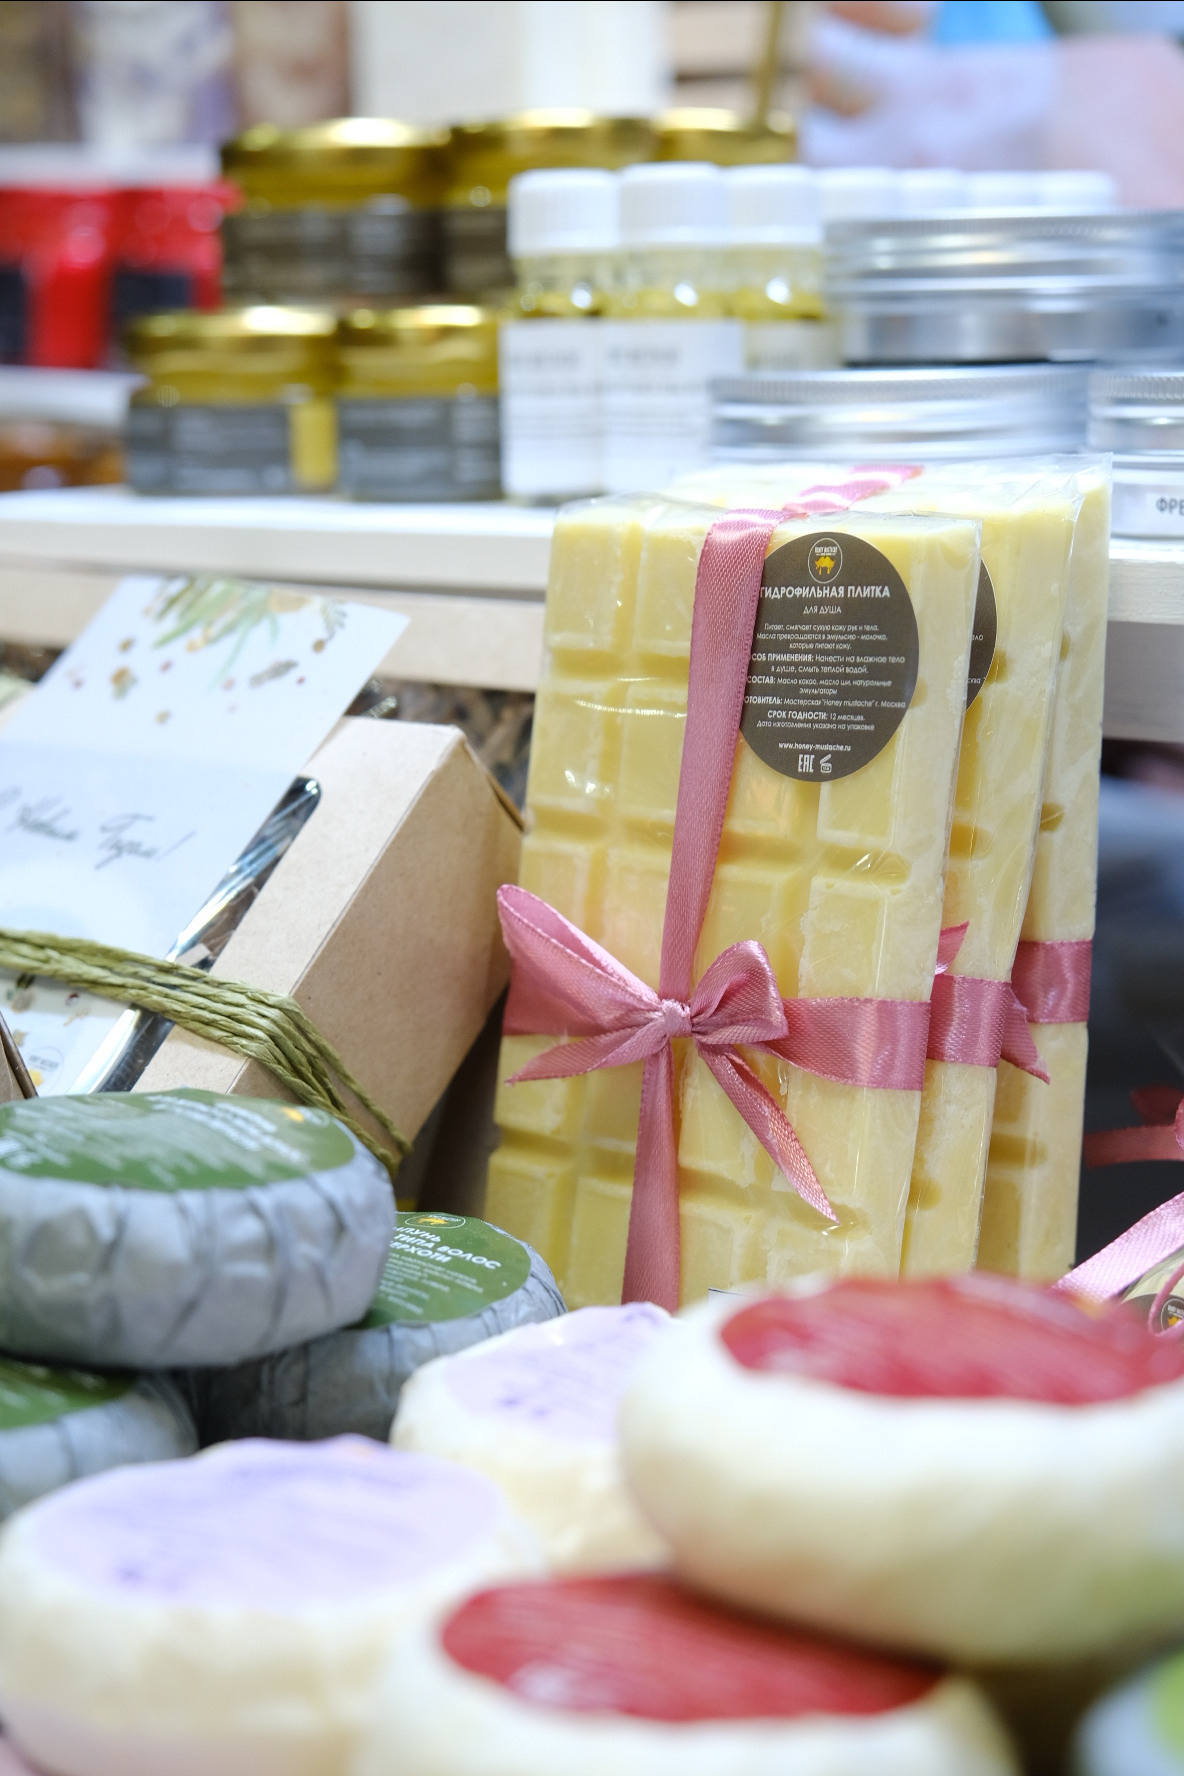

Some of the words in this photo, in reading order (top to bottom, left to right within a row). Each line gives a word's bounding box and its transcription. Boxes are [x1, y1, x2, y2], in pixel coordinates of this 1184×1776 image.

[760, 585, 845, 599] ГИДРОФИЛЬНАЯ
[847, 585, 890, 598] ПЛИТКА
[803, 605, 818, 615] ДЛЯ
[819, 605, 842, 615] ДУША
[751, 652, 767, 662] СОБ
[767, 652, 814, 662] ПРИМЕНЕНИЯ:
[815, 653, 844, 662] Нанести
[856, 655, 887, 663] влажное
[888, 655, 906, 664] тело
[747, 675, 776, 684] СОСТАВ:
[744, 695, 783, 705] ОТОВИТЕЛЬ:
[767, 709, 787, 719] СРОК
[787, 710, 828, 720] ГОДНОСТИ:
[829, 712, 837, 720] 12
[756, 720, 772, 728] Дата
[389, 1241, 453, 1264] ЕРХОТИ
[394, 1233, 435, 1249] ТИПА
[436, 1245, 502, 1270] ВОЛОС
